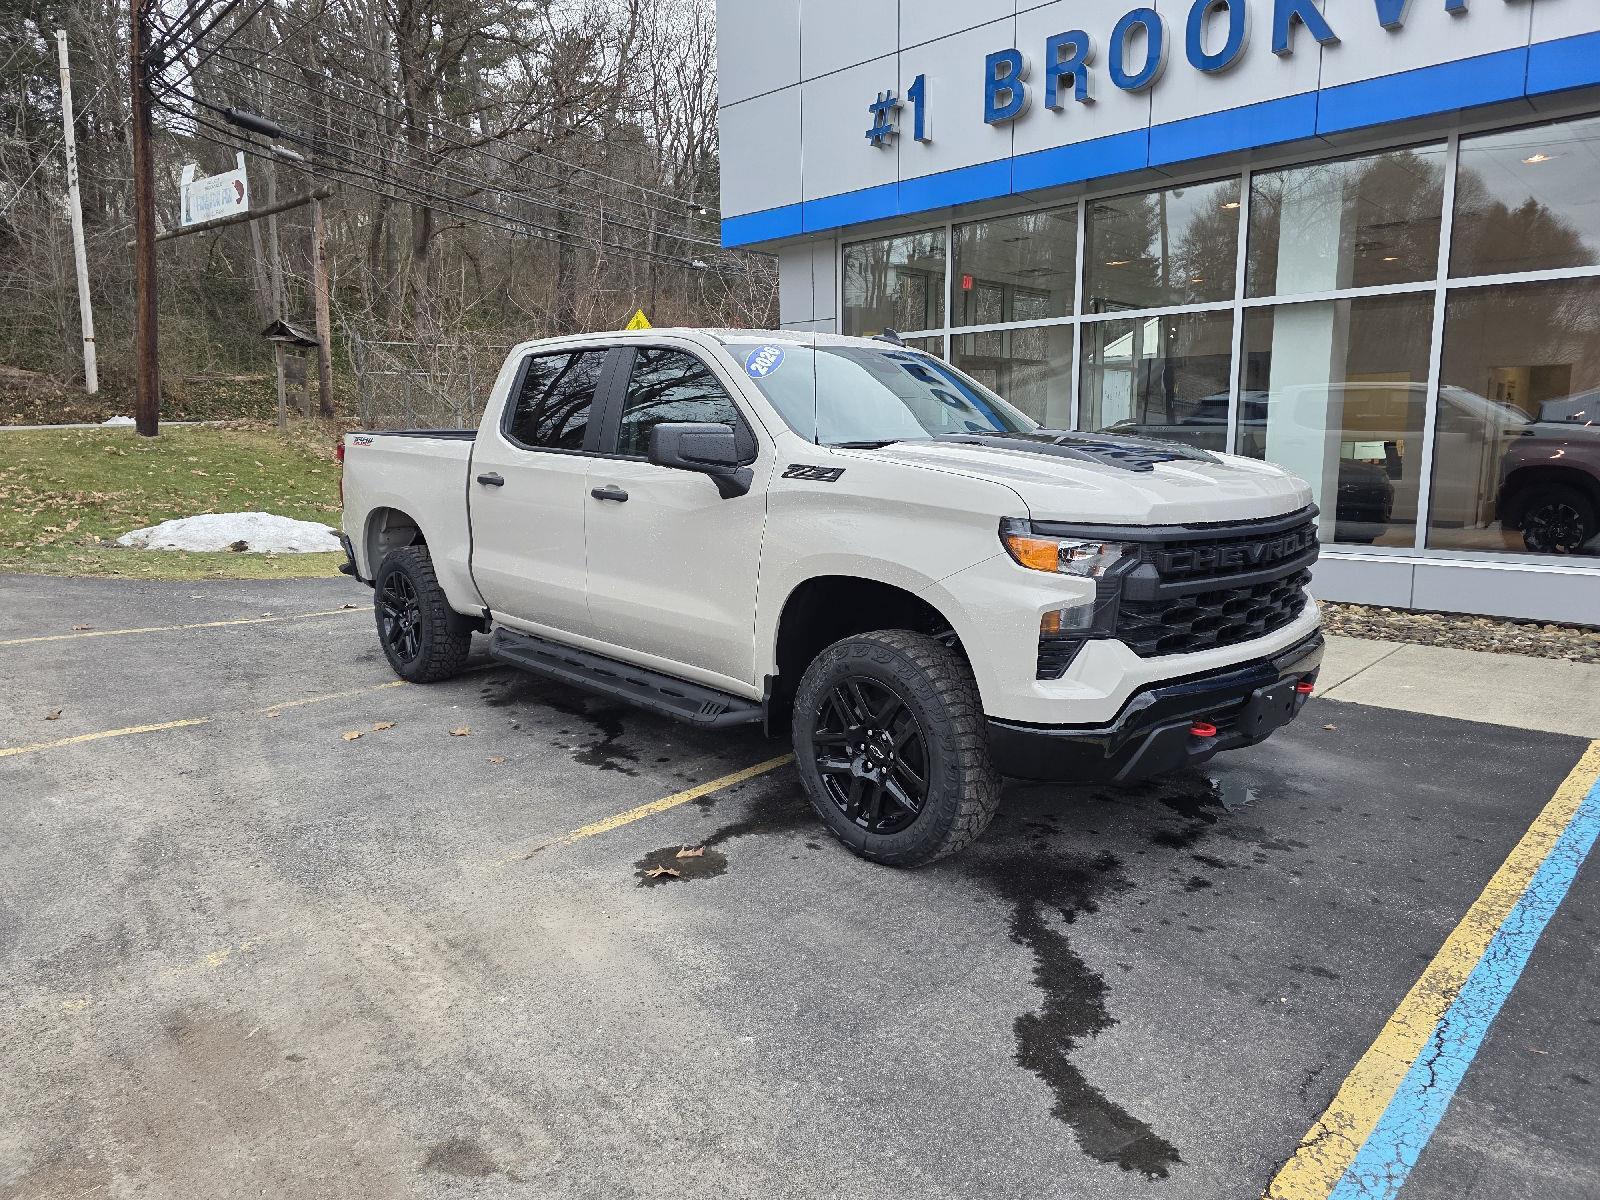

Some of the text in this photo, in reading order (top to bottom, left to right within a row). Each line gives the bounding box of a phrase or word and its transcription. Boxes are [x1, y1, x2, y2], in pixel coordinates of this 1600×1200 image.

[865, 0, 1468, 147] #1 BROOK
[1159, 526, 1316, 572] CHEVROLE
